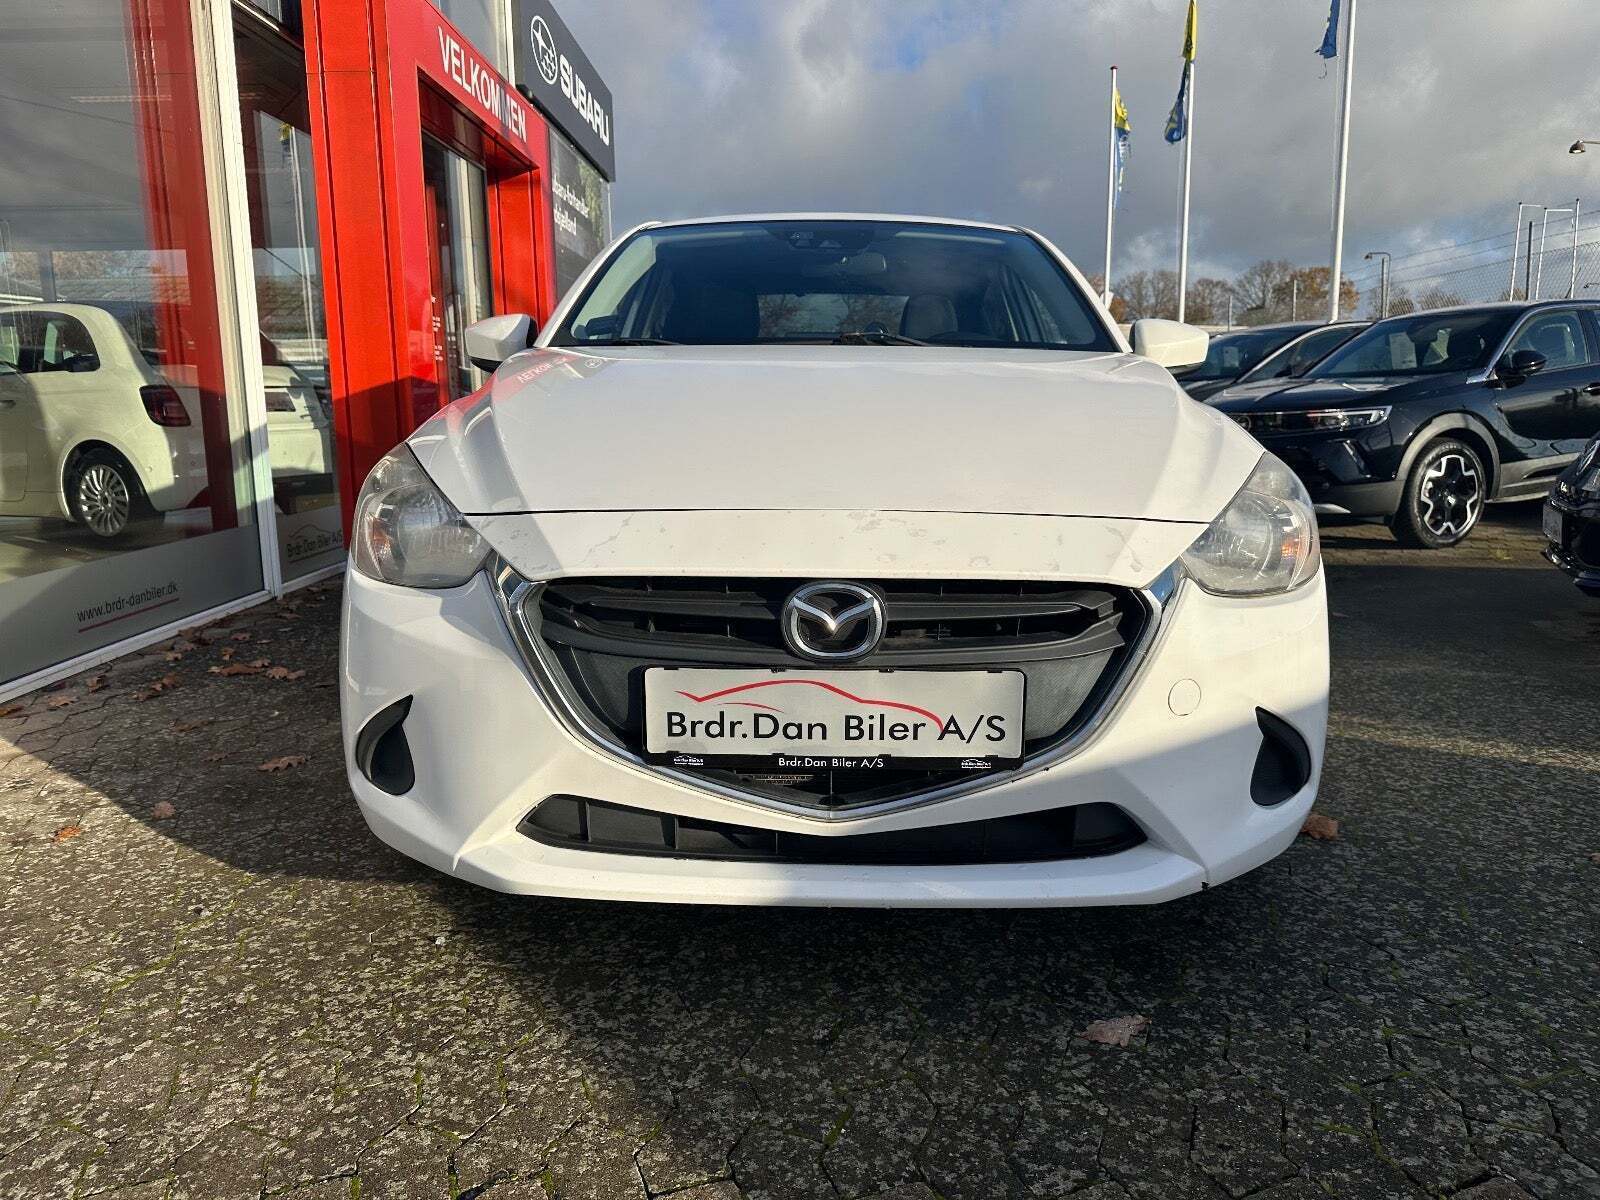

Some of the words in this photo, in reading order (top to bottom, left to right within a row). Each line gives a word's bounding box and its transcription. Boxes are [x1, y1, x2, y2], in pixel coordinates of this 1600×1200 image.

[438, 26, 528, 143] VELKOMMEN
[559, 54, 609, 146] SUBARU
[77, 580, 179, 623] www.brdr-danbiler.dk
[666, 711, 827, 740] Brdr.Dan
[844, 713, 926, 742] Biler
[936, 714, 1006, 744] A/S
[778, 756, 827, 768] Brdr.Dan
[832, 757, 857, 769] Biler
[861, 757, 884, 769] A/S
